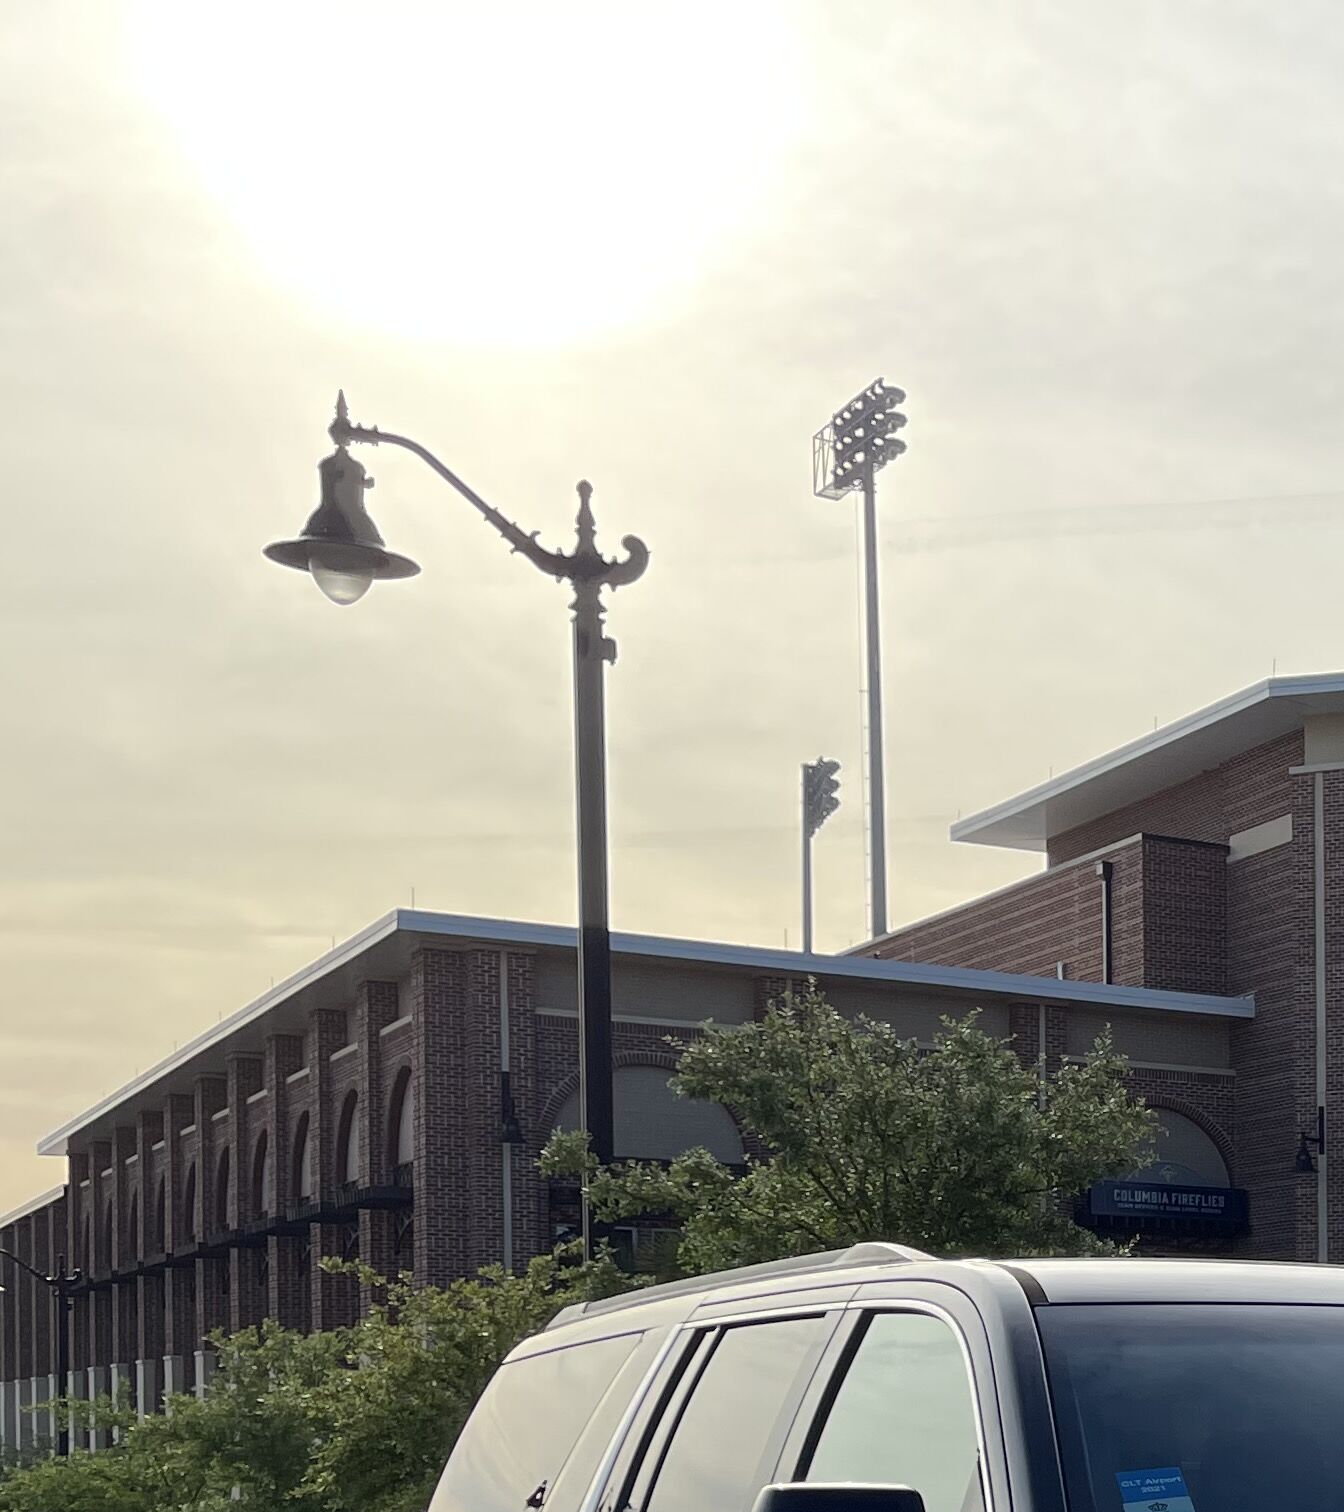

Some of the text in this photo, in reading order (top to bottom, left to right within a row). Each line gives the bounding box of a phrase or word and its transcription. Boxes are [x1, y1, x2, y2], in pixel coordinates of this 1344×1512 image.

[1113, 1189, 1225, 1208] COLUMBIA FIREFLIES
[1120, 1479, 1141, 1488] CLT
